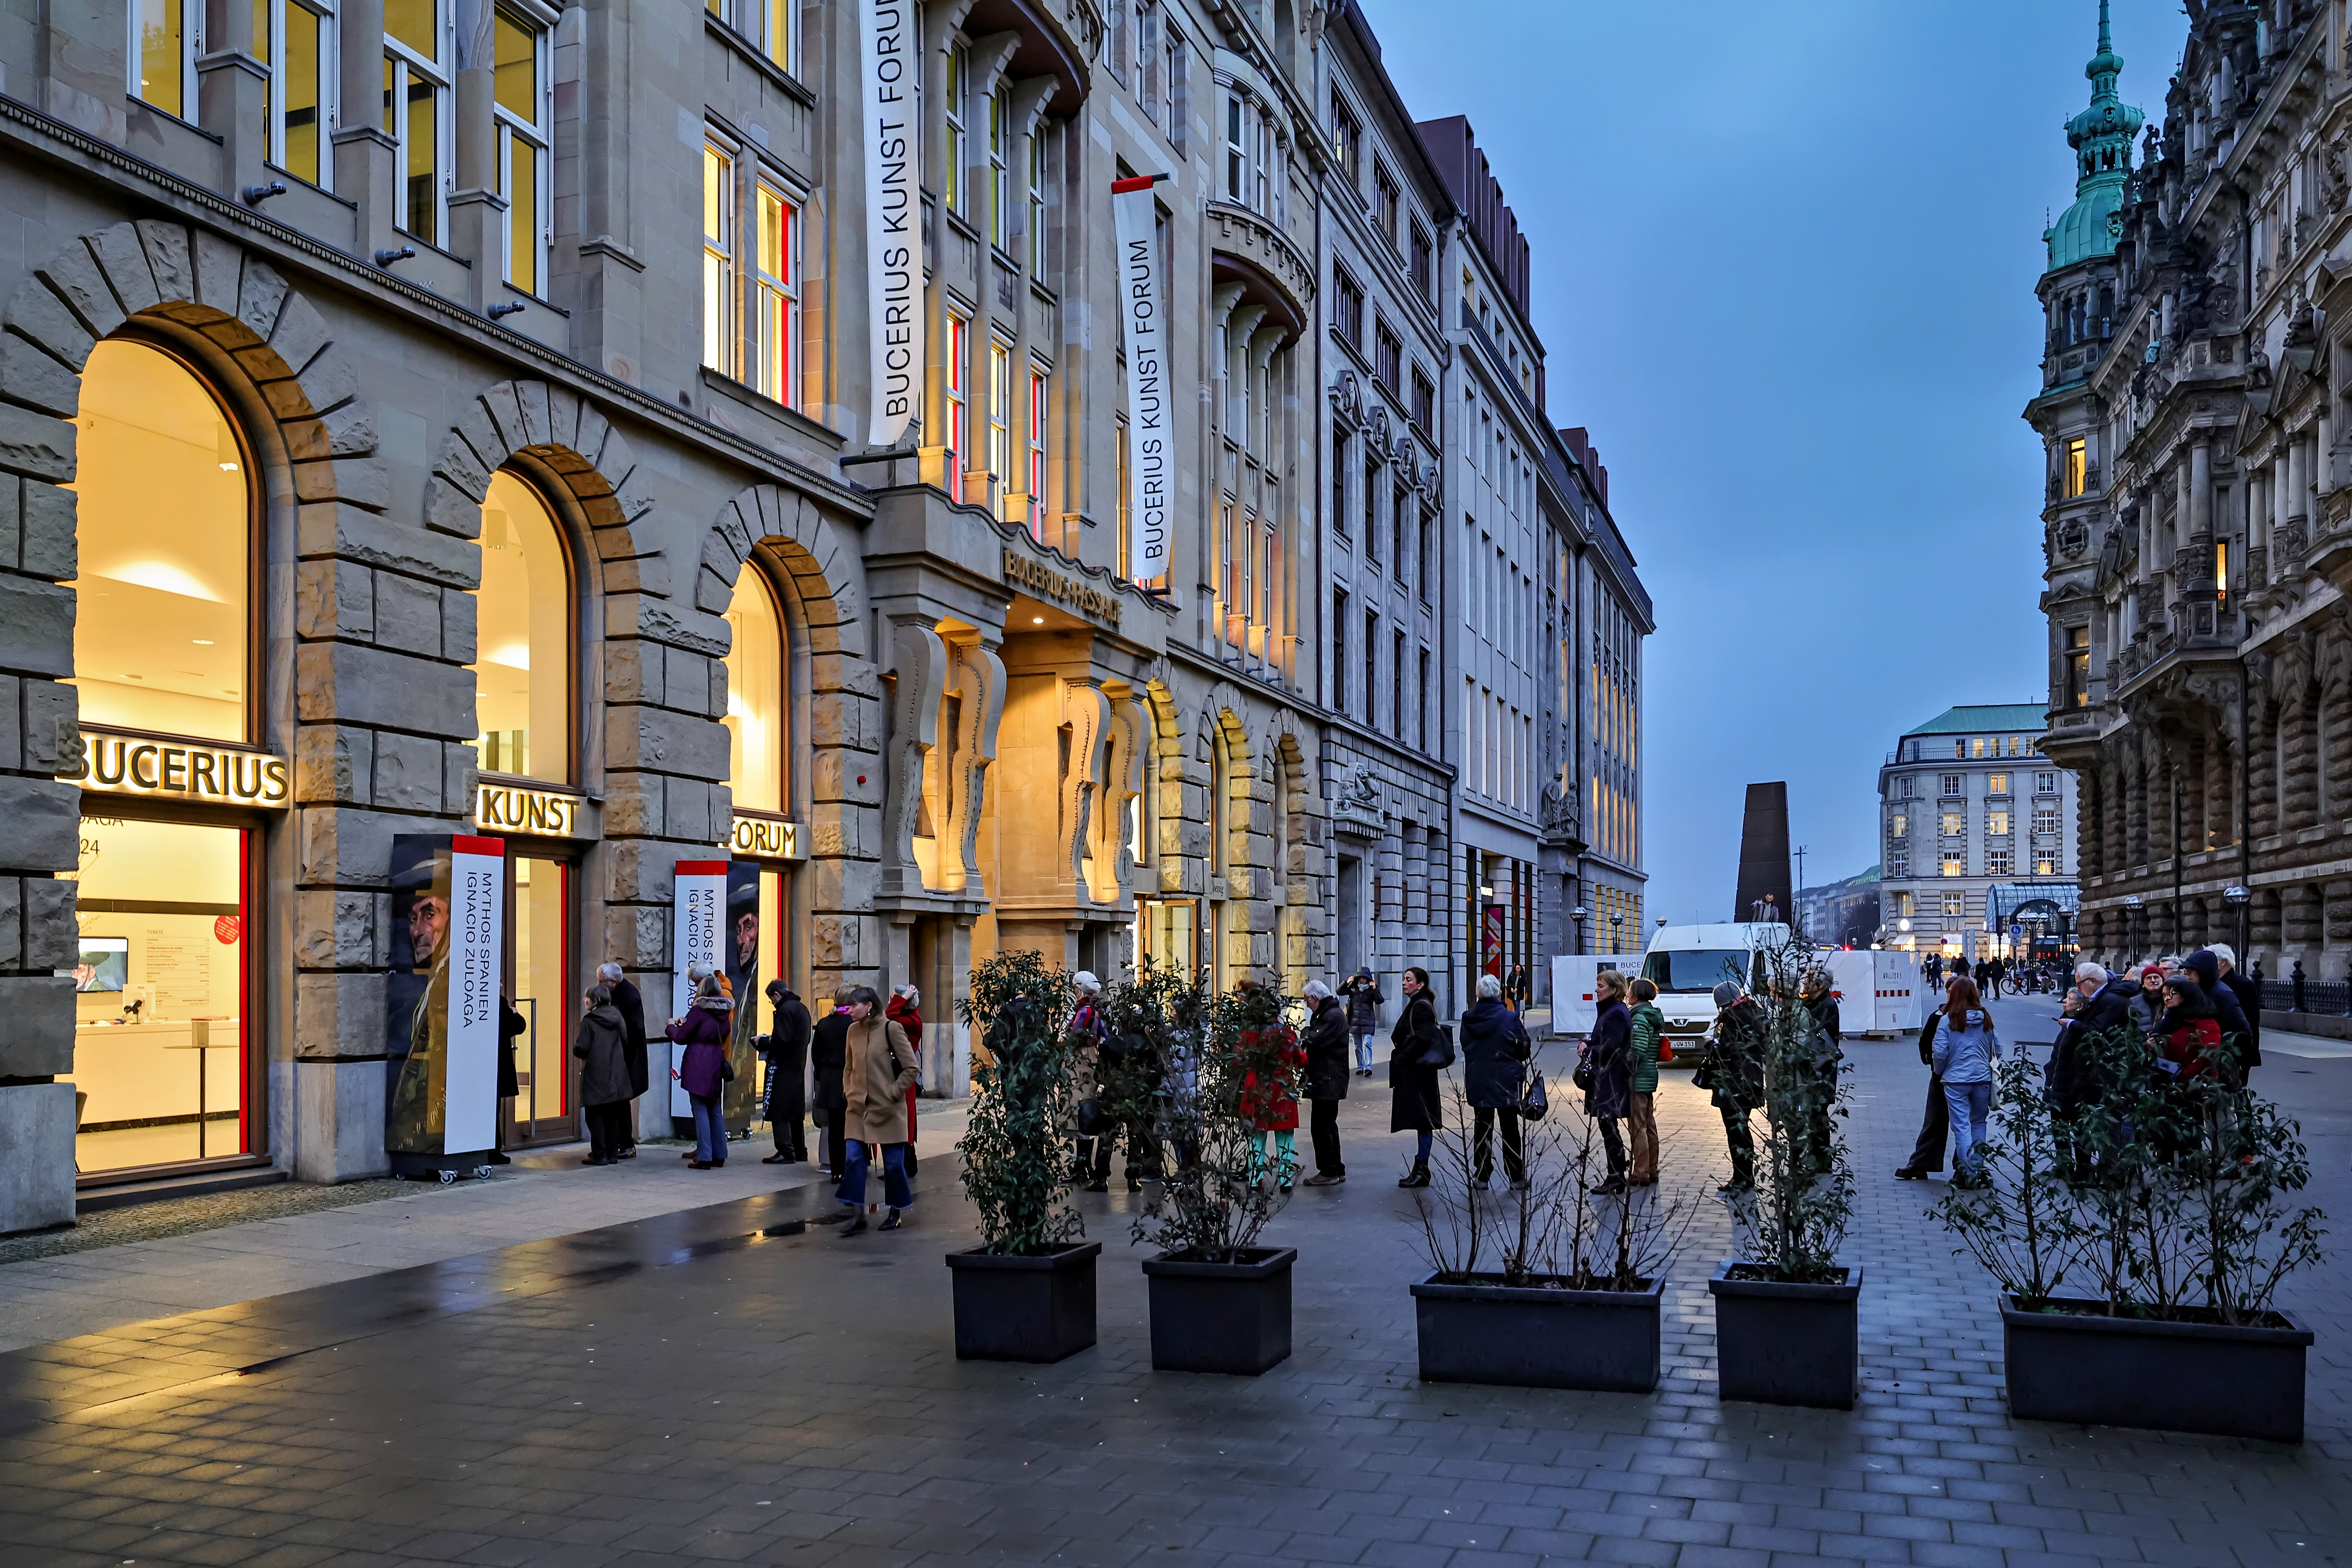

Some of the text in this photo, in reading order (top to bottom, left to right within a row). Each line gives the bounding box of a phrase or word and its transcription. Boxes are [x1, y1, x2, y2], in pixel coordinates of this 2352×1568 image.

[879, 118, 908, 233] KUNST
[884, 248, 911, 417] BUCERIUS
[1128, 240, 1164, 559] BUCERIUS KUNST FORUM
[1004, 549, 1123, 625] BUCERIUS-PASSAGE
[482, 789, 580, 832] KUNST
[732, 821, 796, 854] ORUM
[688, 890, 699, 947] IGNACIO
[703, 890, 714, 948] MYTHOS
[975, 903, 981, 913] 12
[463, 872, 477, 1028] IGNACIO ZULOAGA
[479, 873, 492, 1021] MYTHOS SPANIEN
